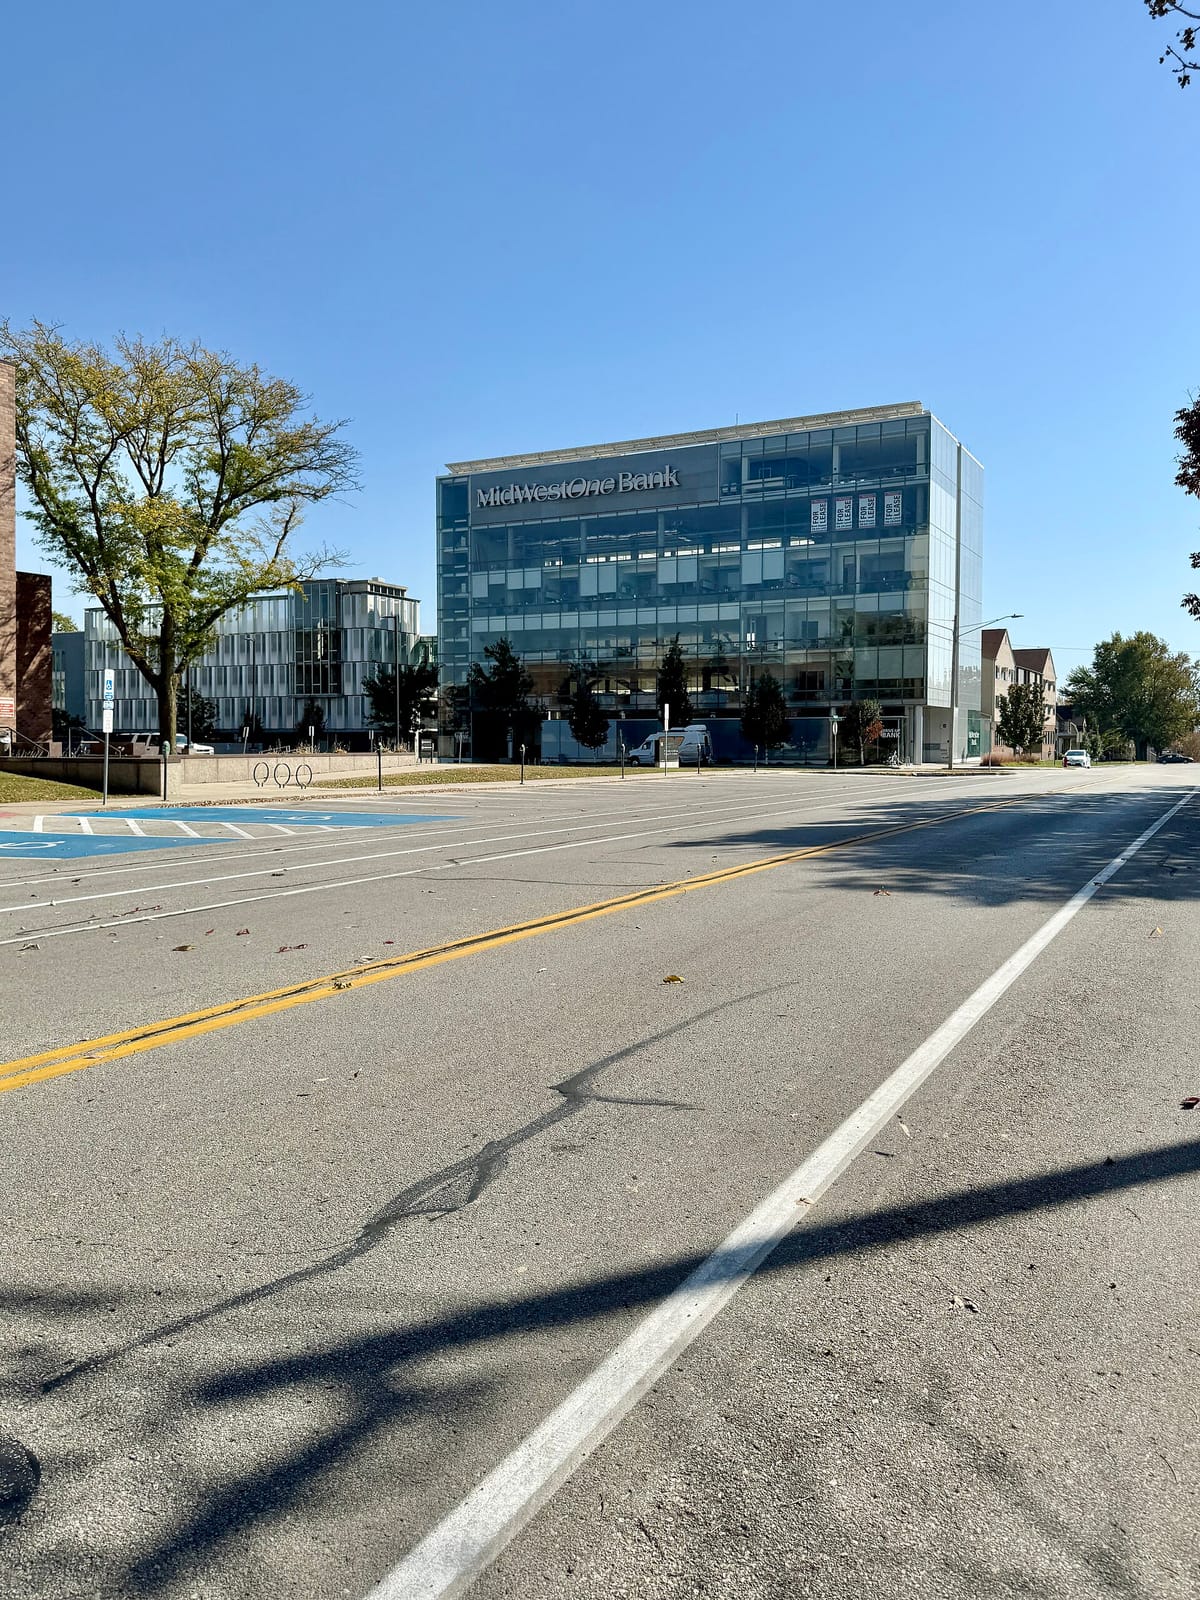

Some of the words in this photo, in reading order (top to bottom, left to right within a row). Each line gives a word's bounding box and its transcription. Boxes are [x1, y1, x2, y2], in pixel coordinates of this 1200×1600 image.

[476, 477, 616, 507] MidWestOne
[617, 464, 680, 494] Bank
[819, 503, 827, 524] LEASE
[844, 500, 852, 521] LEASE
[860, 506, 868, 520] FOR
[867, 497, 875, 519] LEASE
[885, 503, 893, 517] FOR
[893, 495, 901, 516] LEASE
